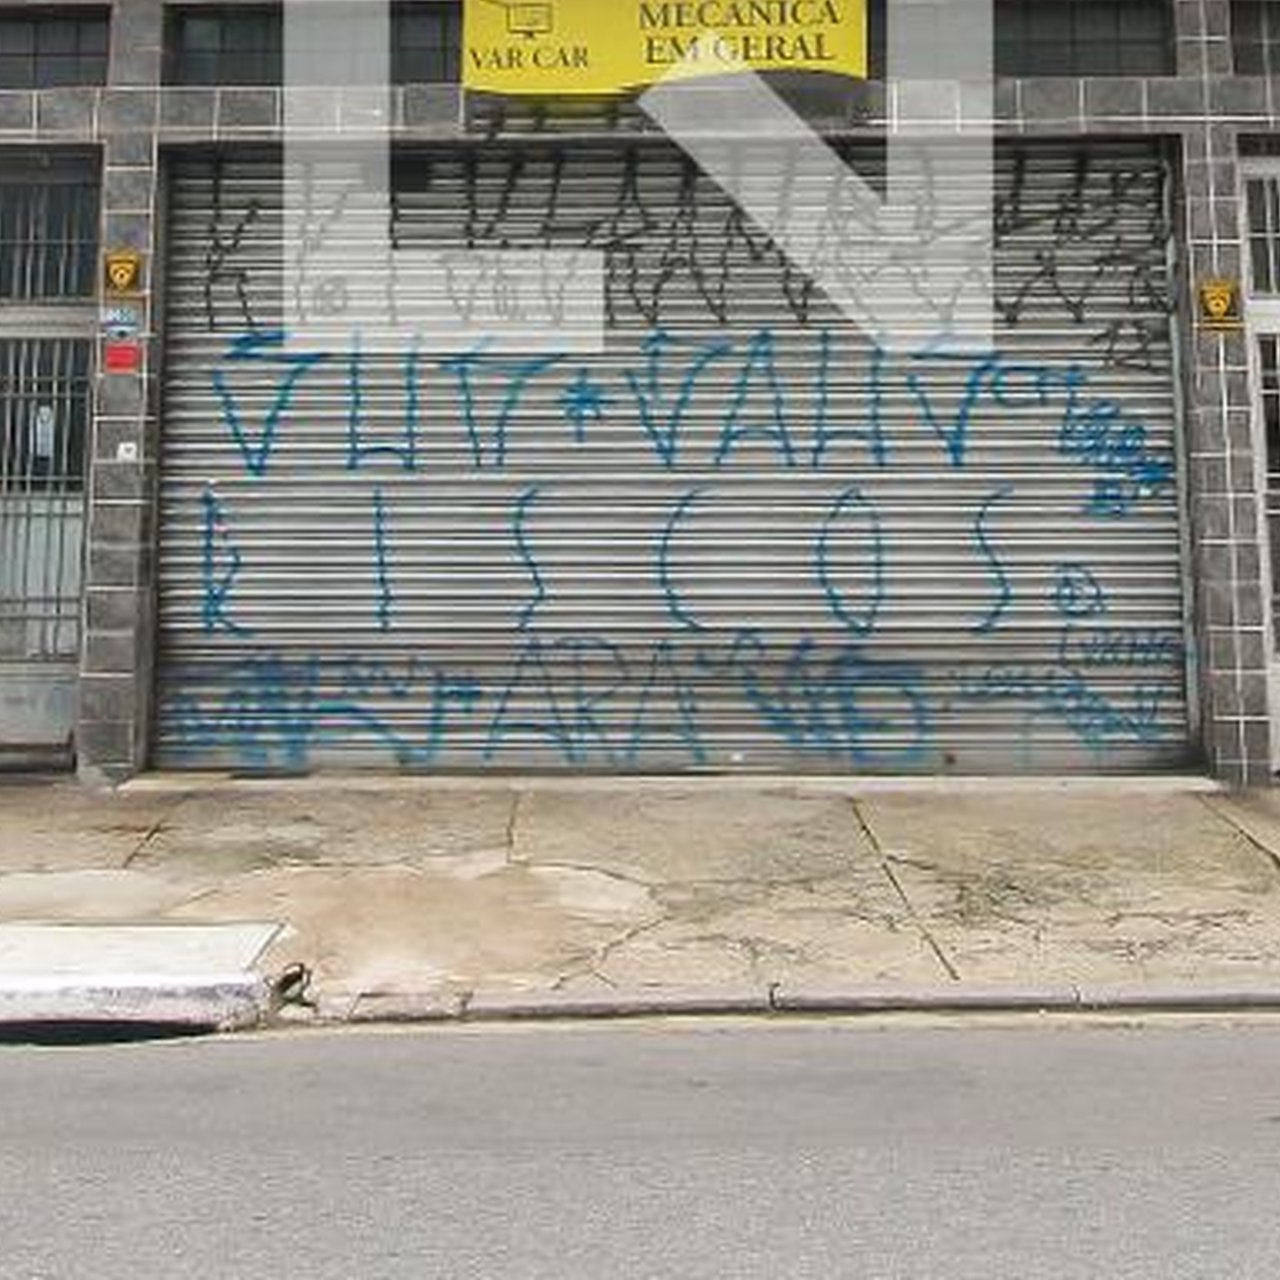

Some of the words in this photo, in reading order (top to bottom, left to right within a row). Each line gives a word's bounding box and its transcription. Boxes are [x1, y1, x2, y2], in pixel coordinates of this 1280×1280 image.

[470, 49, 524, 70] VAR
[533, 47, 589, 68] CAR
[646, 35, 700, 64] EM
[714, 31, 836, 63] GERAL
